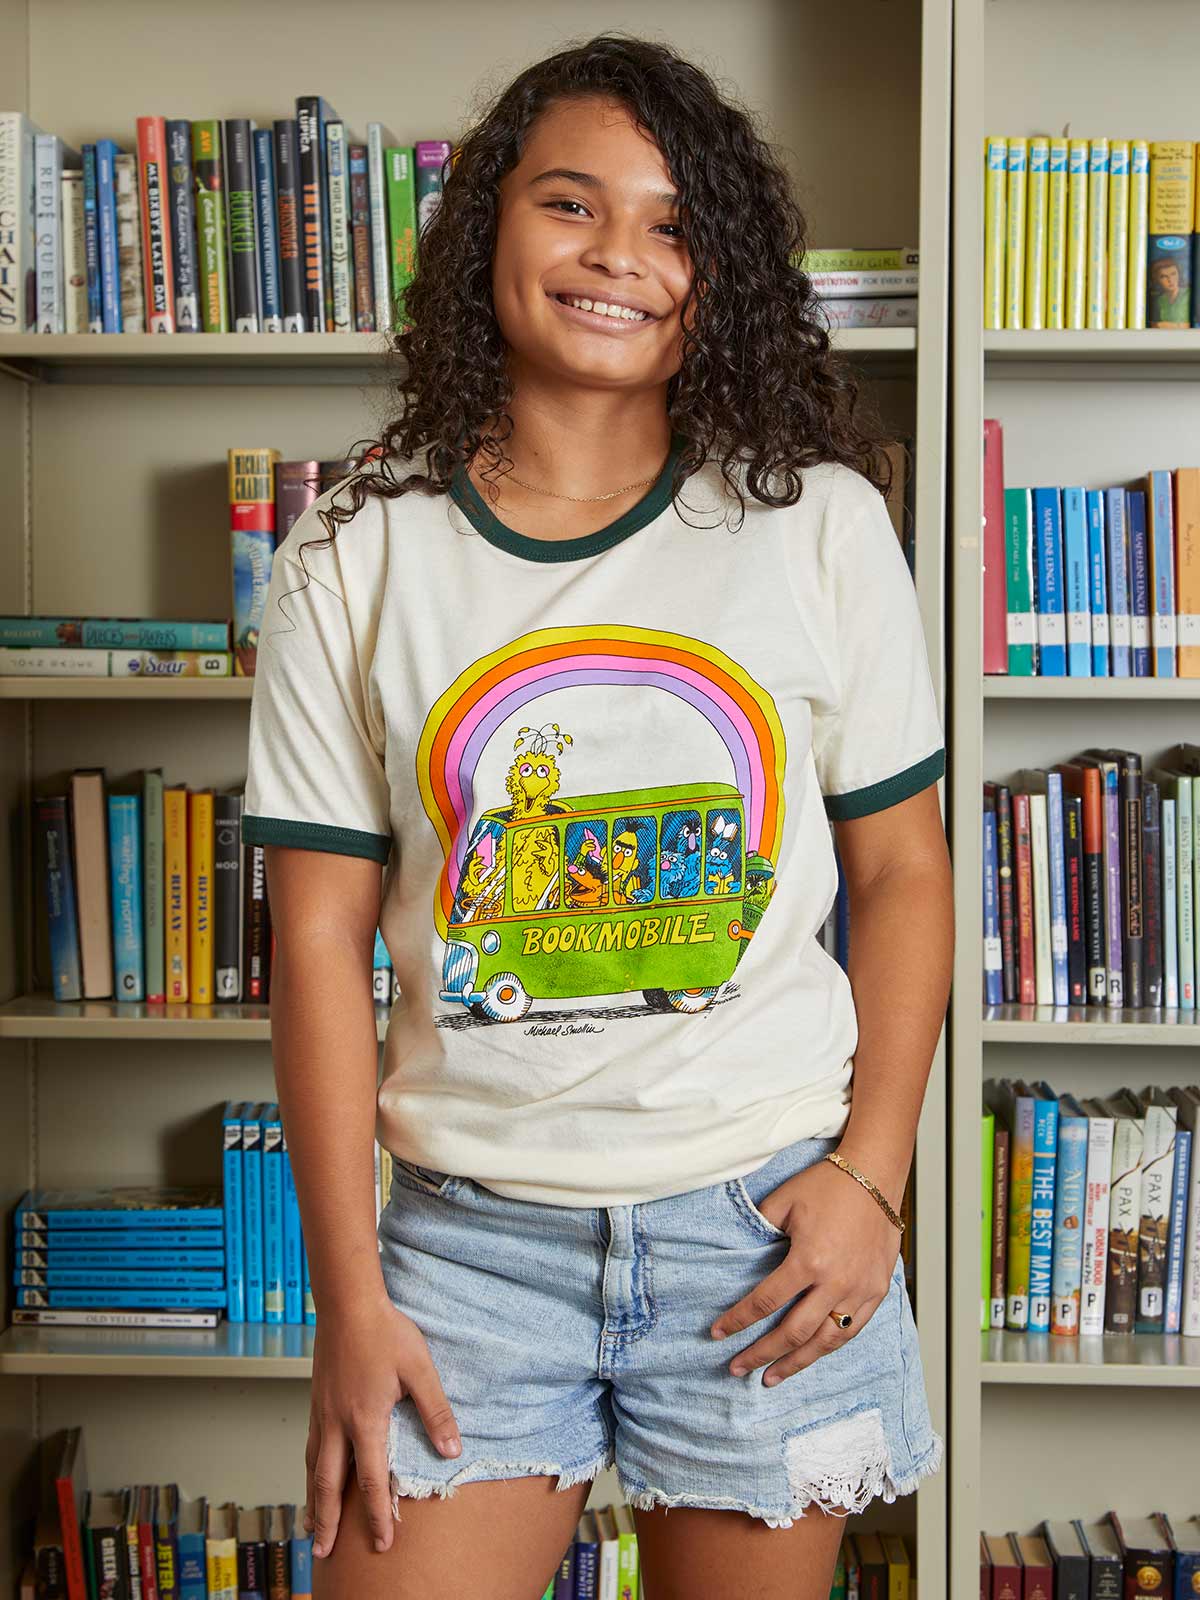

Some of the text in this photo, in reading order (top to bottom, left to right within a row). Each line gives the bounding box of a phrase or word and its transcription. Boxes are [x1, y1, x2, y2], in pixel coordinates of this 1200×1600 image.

[200, 130, 212, 153] AVI
[298, 109, 311, 153] LUPICA
[309, 117, 318, 140] MIKE
[148, 188, 161, 236] BIXBY'S
[332, 180, 344, 213] WORLD
[229, 191, 256, 253] BOOKED
[279, 195, 298, 260] CROSSOVER
[303, 182, 321, 291] THE BATBOY
[334, 219, 344, 237] WAR
[37, 233, 55, 314] QUEEN
[152, 241, 164, 275] LAST
[154, 284, 166, 311] DAY
[181, 305, 192, 321] A
[207, 271, 220, 325] TRAITOR
[235, 455, 272, 474] MICHAEL
[1044, 507, 1054, 557] MADELEINE
[1135, 531, 1145, 578] MADELEINE
[145, 657, 187, 674] Soar
[205, 659, 220, 670] B
[1069, 811, 1077, 839] RASKIN
[118, 835, 133, 885] waiting
[215, 861, 238, 870] MOO
[252, 847, 264, 900] ELIJAH
[171, 874, 182, 932] REPLAY
[198, 876, 209, 933] REPLAY
[1070, 857, 1081, 942] THE WESTING GAME
[121, 900, 137, 950] normal
[520, 911, 717, 957] BOOKMOBILE
[1003, 884, 1013, 961] RARE BEASTS
[123, 974, 135, 990] C
[374, 977, 384, 992] C
[1095, 974, 1104, 989] P
[1111, 979, 1120, 993] R
[523, 1022, 562, 1037] Michael
[1036, 1119, 1046, 1137] PECK
[1043, 1112, 1055, 1145] RICHARD
[1176, 1138, 1188, 1195] PHILBRICK
[1119, 1187, 1133, 1217] PAX
[1147, 1174, 1163, 1204] PAX
[1029, 1166, 1054, 1294] THE BEST MAN
[1174, 1199, 1186, 1234] FREAK
[1093, 1228, 1106, 1286] ROBIN HOOD
[1173, 1237, 1184, 1257] THE
[994, 1304, 1003, 1318] P
[1013, 1301, 1023, 1316] P
[1037, 1303, 1047, 1318] P
[1061, 1303, 1072, 1318] P
[1087, 1293, 1096, 1307] P
[1147, 1294, 1157, 1308] P
[86, 1315, 146, 1323] OLD YELLER
[101, 1537, 117, 1579] GREEN
[157, 1542, 175, 1590] JETER
